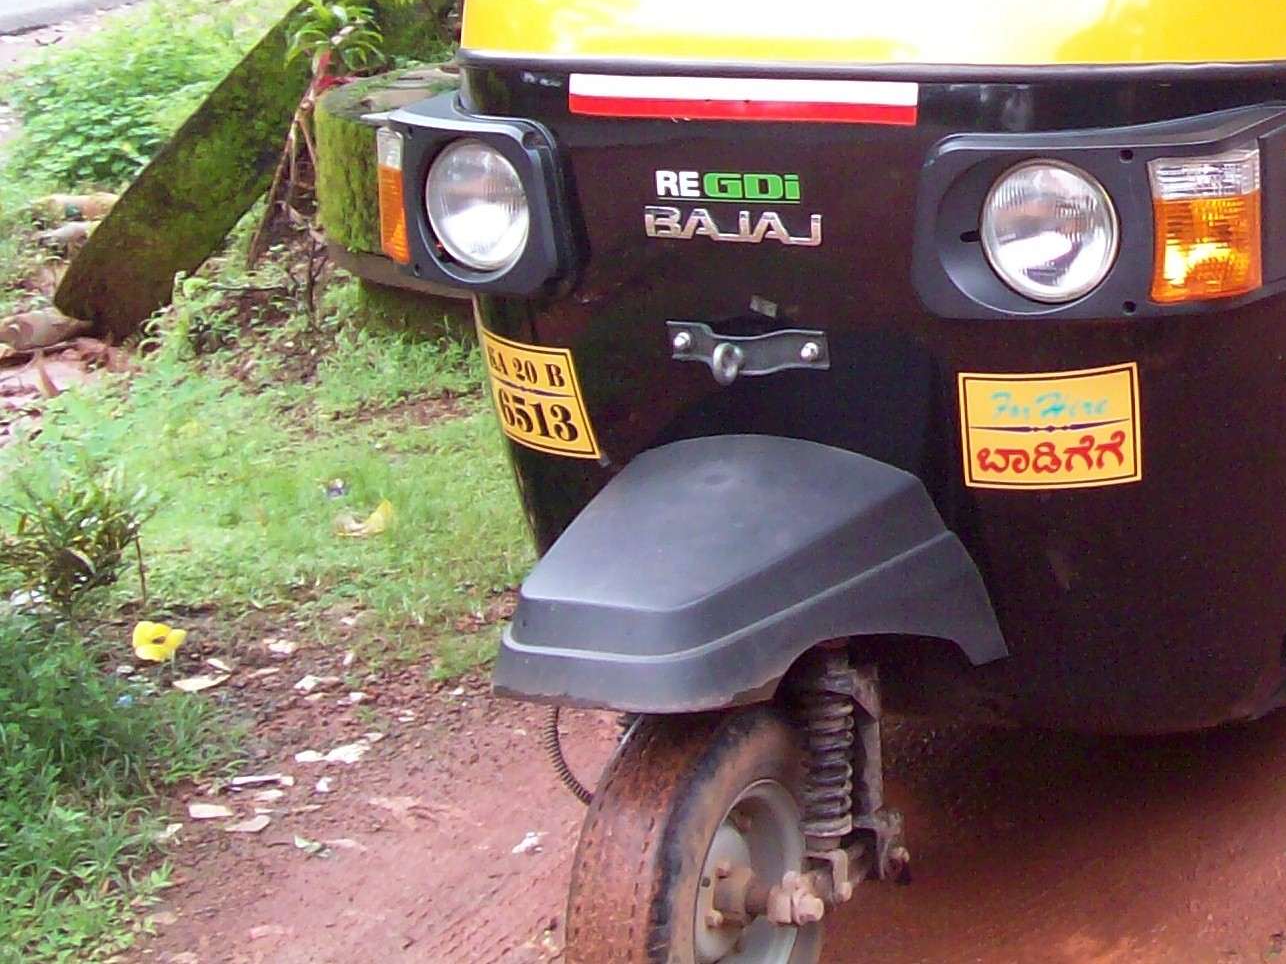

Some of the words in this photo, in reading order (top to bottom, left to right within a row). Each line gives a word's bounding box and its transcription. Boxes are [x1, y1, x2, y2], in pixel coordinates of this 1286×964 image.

[644, 205, 823, 247] BAJAJ
[512, 357, 538, 385] 20
[544, 363, 566, 388] B
[498, 388, 579, 442] 6513
[976, 429, 1127, 474] ಬಾಡಿಗೆಗೆ
